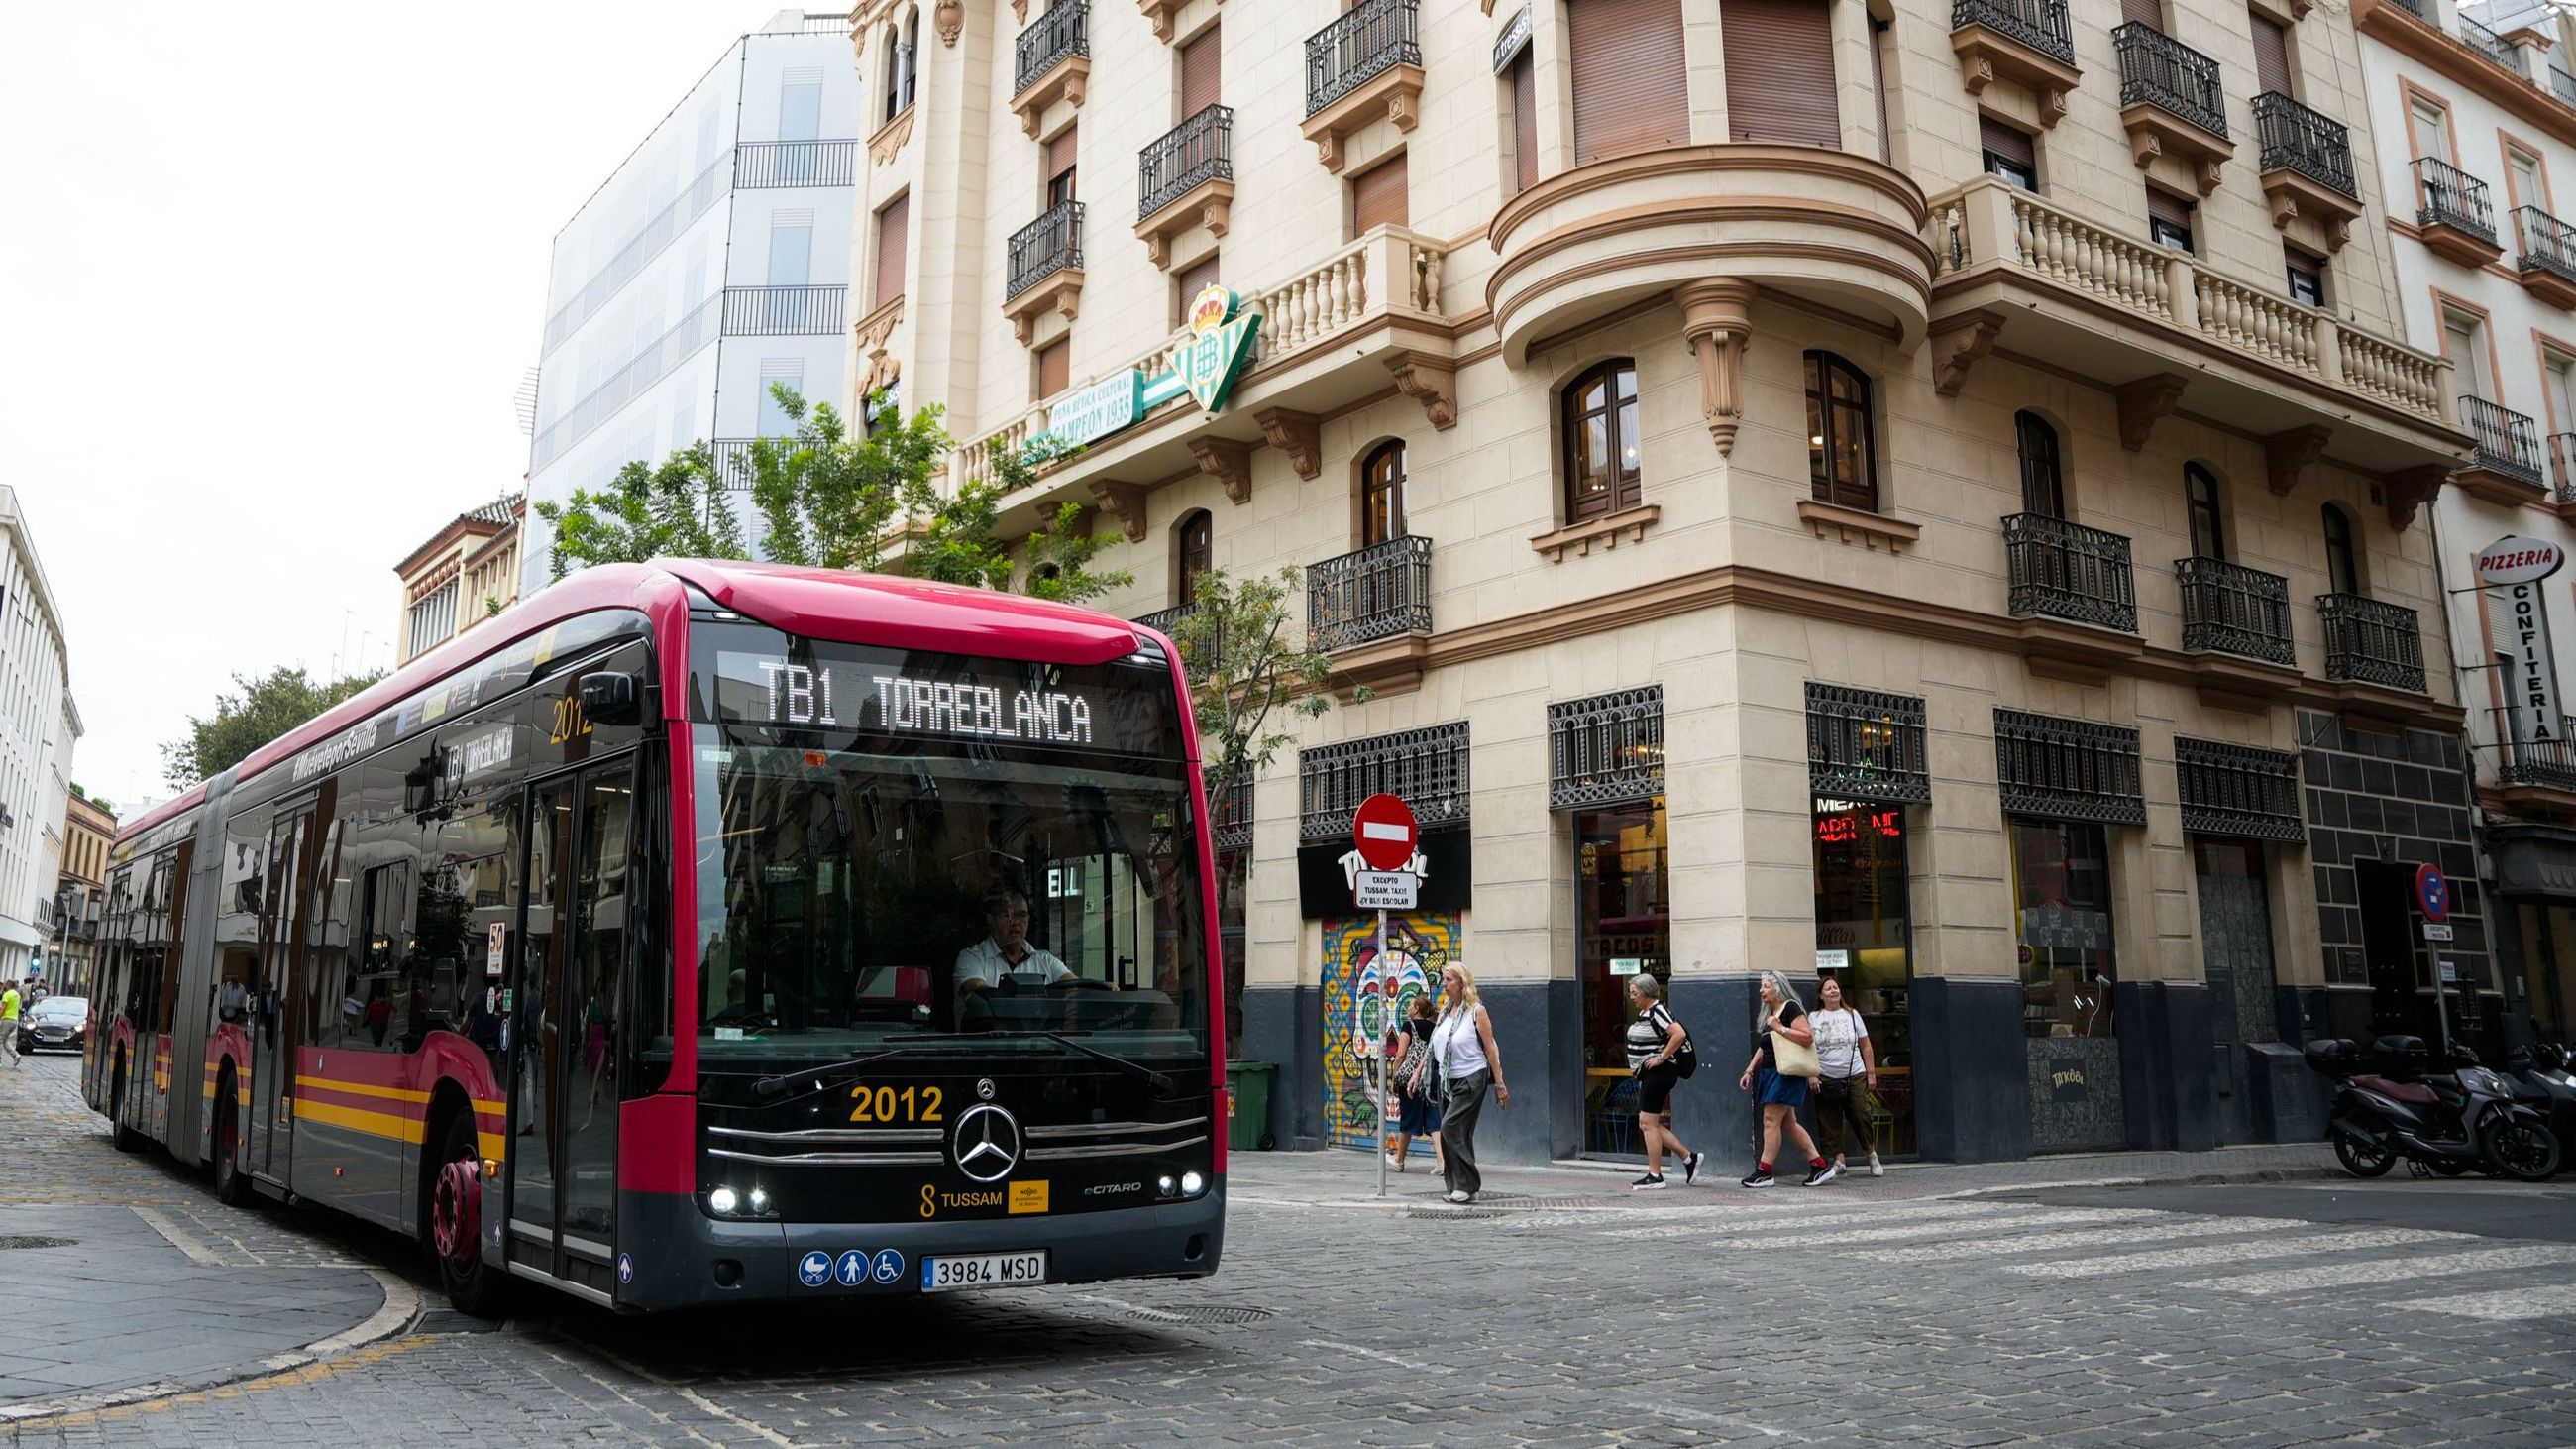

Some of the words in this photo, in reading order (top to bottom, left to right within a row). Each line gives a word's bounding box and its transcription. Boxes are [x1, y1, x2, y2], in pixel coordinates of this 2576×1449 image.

[1098, 376, 1129, 402] CULTURAL
[1106, 393, 1129, 427] 1935
[2480, 548, 2553, 571] PIZZERIA
[2513, 585, 2551, 739] CONFITERIA
[759, 661, 836, 724] TB1
[873, 676, 1091, 743] TORREBLANCA
[1372, 876, 1399, 885] EXCEPTO
[1586, 936, 1655, 955] TACOS
[849, 1085, 943, 1123] 2012
[941, 1192, 1003, 1208] TUSSAM
[937, 1259, 992, 1285] 3984
[1000, 1256, 1039, 1282] MSD
